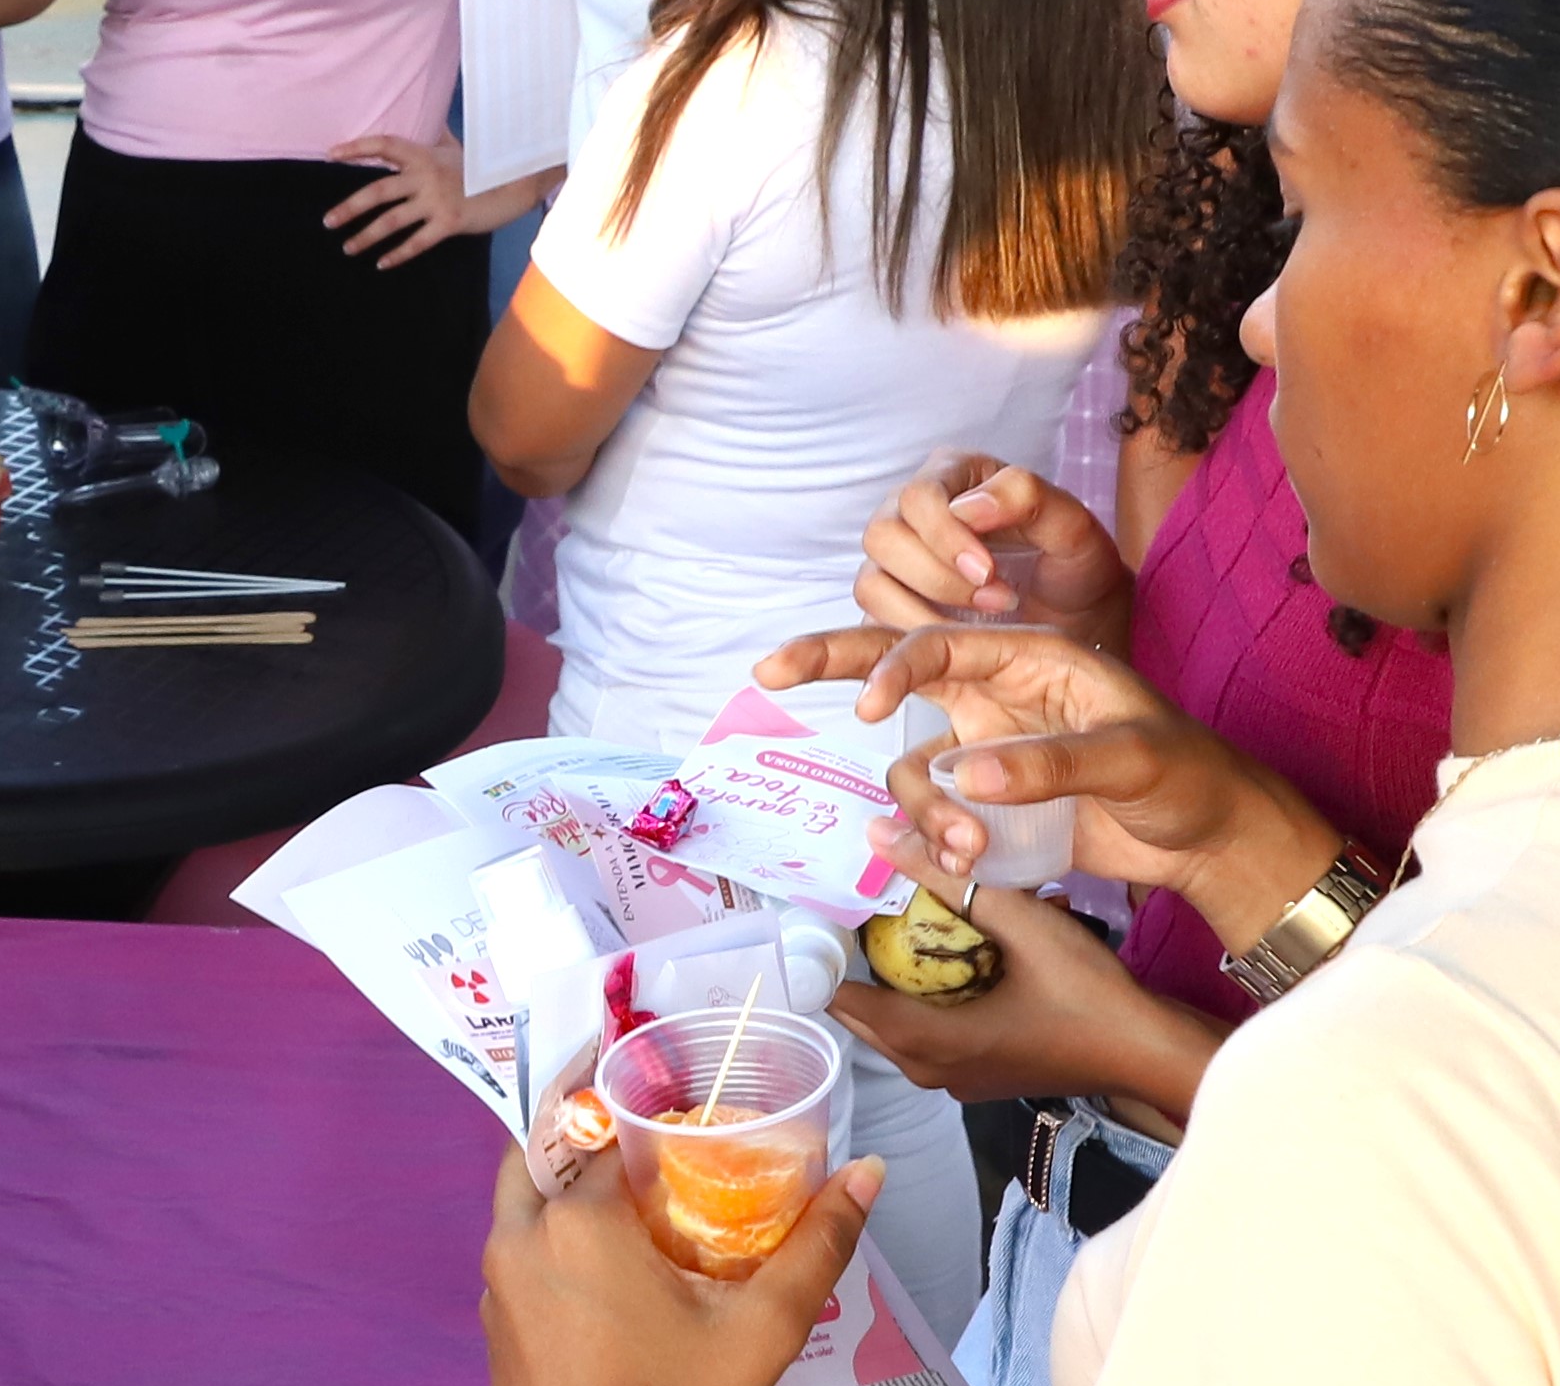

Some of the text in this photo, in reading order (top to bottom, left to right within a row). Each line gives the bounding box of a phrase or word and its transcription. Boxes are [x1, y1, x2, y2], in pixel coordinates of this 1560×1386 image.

[763, 752, 894, 804] OUTUBRO ROSA
[696, 781, 840, 835] Ei garota
[607, 856, 635, 922] ENTENDA
